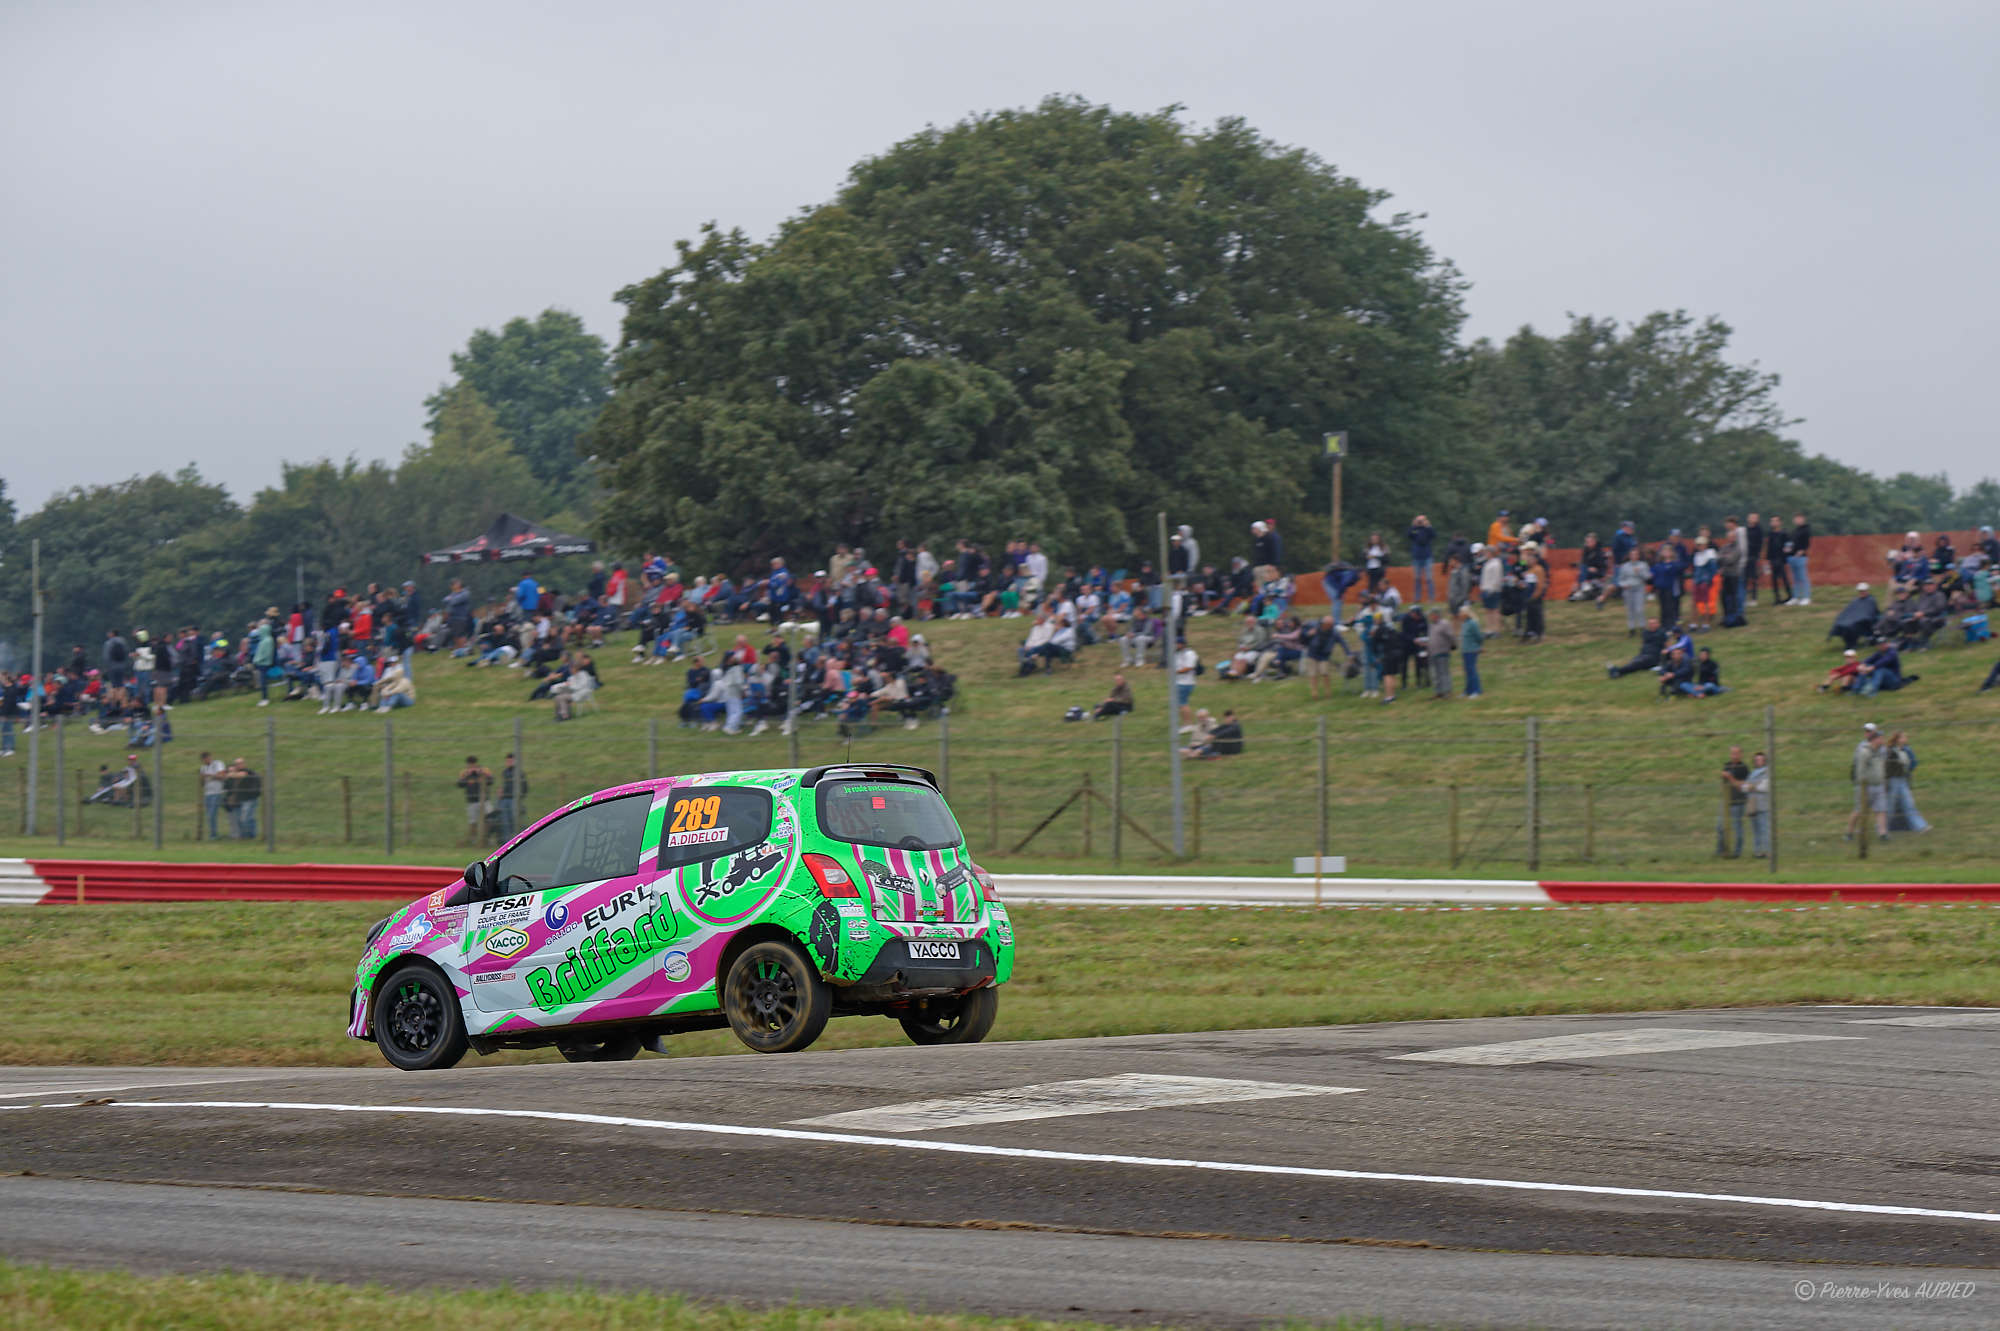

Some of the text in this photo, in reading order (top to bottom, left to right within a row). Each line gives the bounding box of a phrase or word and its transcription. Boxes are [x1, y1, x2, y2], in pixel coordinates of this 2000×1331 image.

[669, 795, 722, 833] 289
[669, 830, 726, 846] A.DIDELOT
[480, 896, 530, 915] FFSA
[583, 885, 653, 931] EURL
[477, 915, 498, 924] COUPE
[507, 910, 531, 919] FRANCE
[489, 935, 525, 949] YACCO
[912, 943, 957, 957] YACCO
[525, 892, 678, 1011] Briffard
[475, 972, 502, 982] RALLYCROSS
